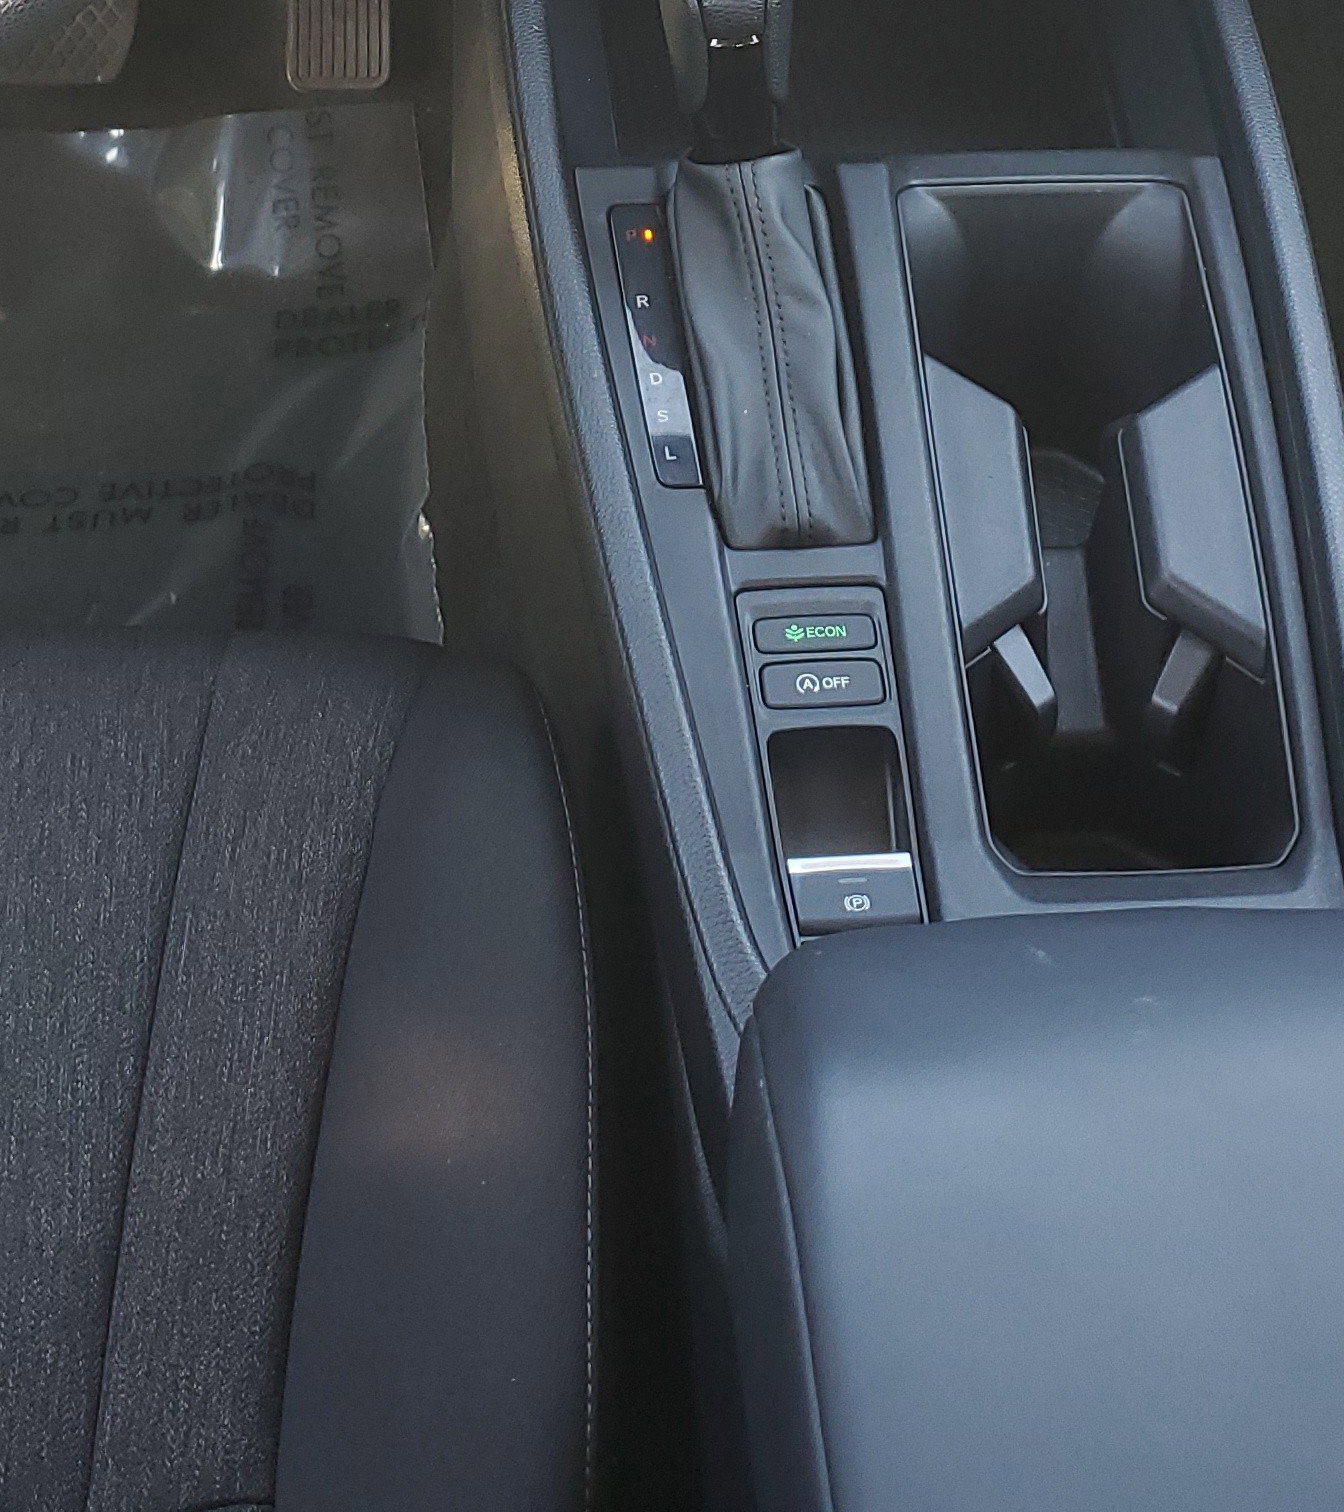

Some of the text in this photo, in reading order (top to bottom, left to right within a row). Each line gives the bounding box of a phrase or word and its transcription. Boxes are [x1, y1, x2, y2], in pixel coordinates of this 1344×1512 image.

[267, 124, 302, 231] COVER
[309, 166, 346, 299] REMOVE
[636, 295, 649, 308] R
[650, 372, 663, 385] D
[658, 410, 669, 422] S
[664, 447, 677, 460] L
[47, 505, 157, 534] MUST
[806, 626, 847, 638] ECON
[822, 676, 851, 688] OFF
